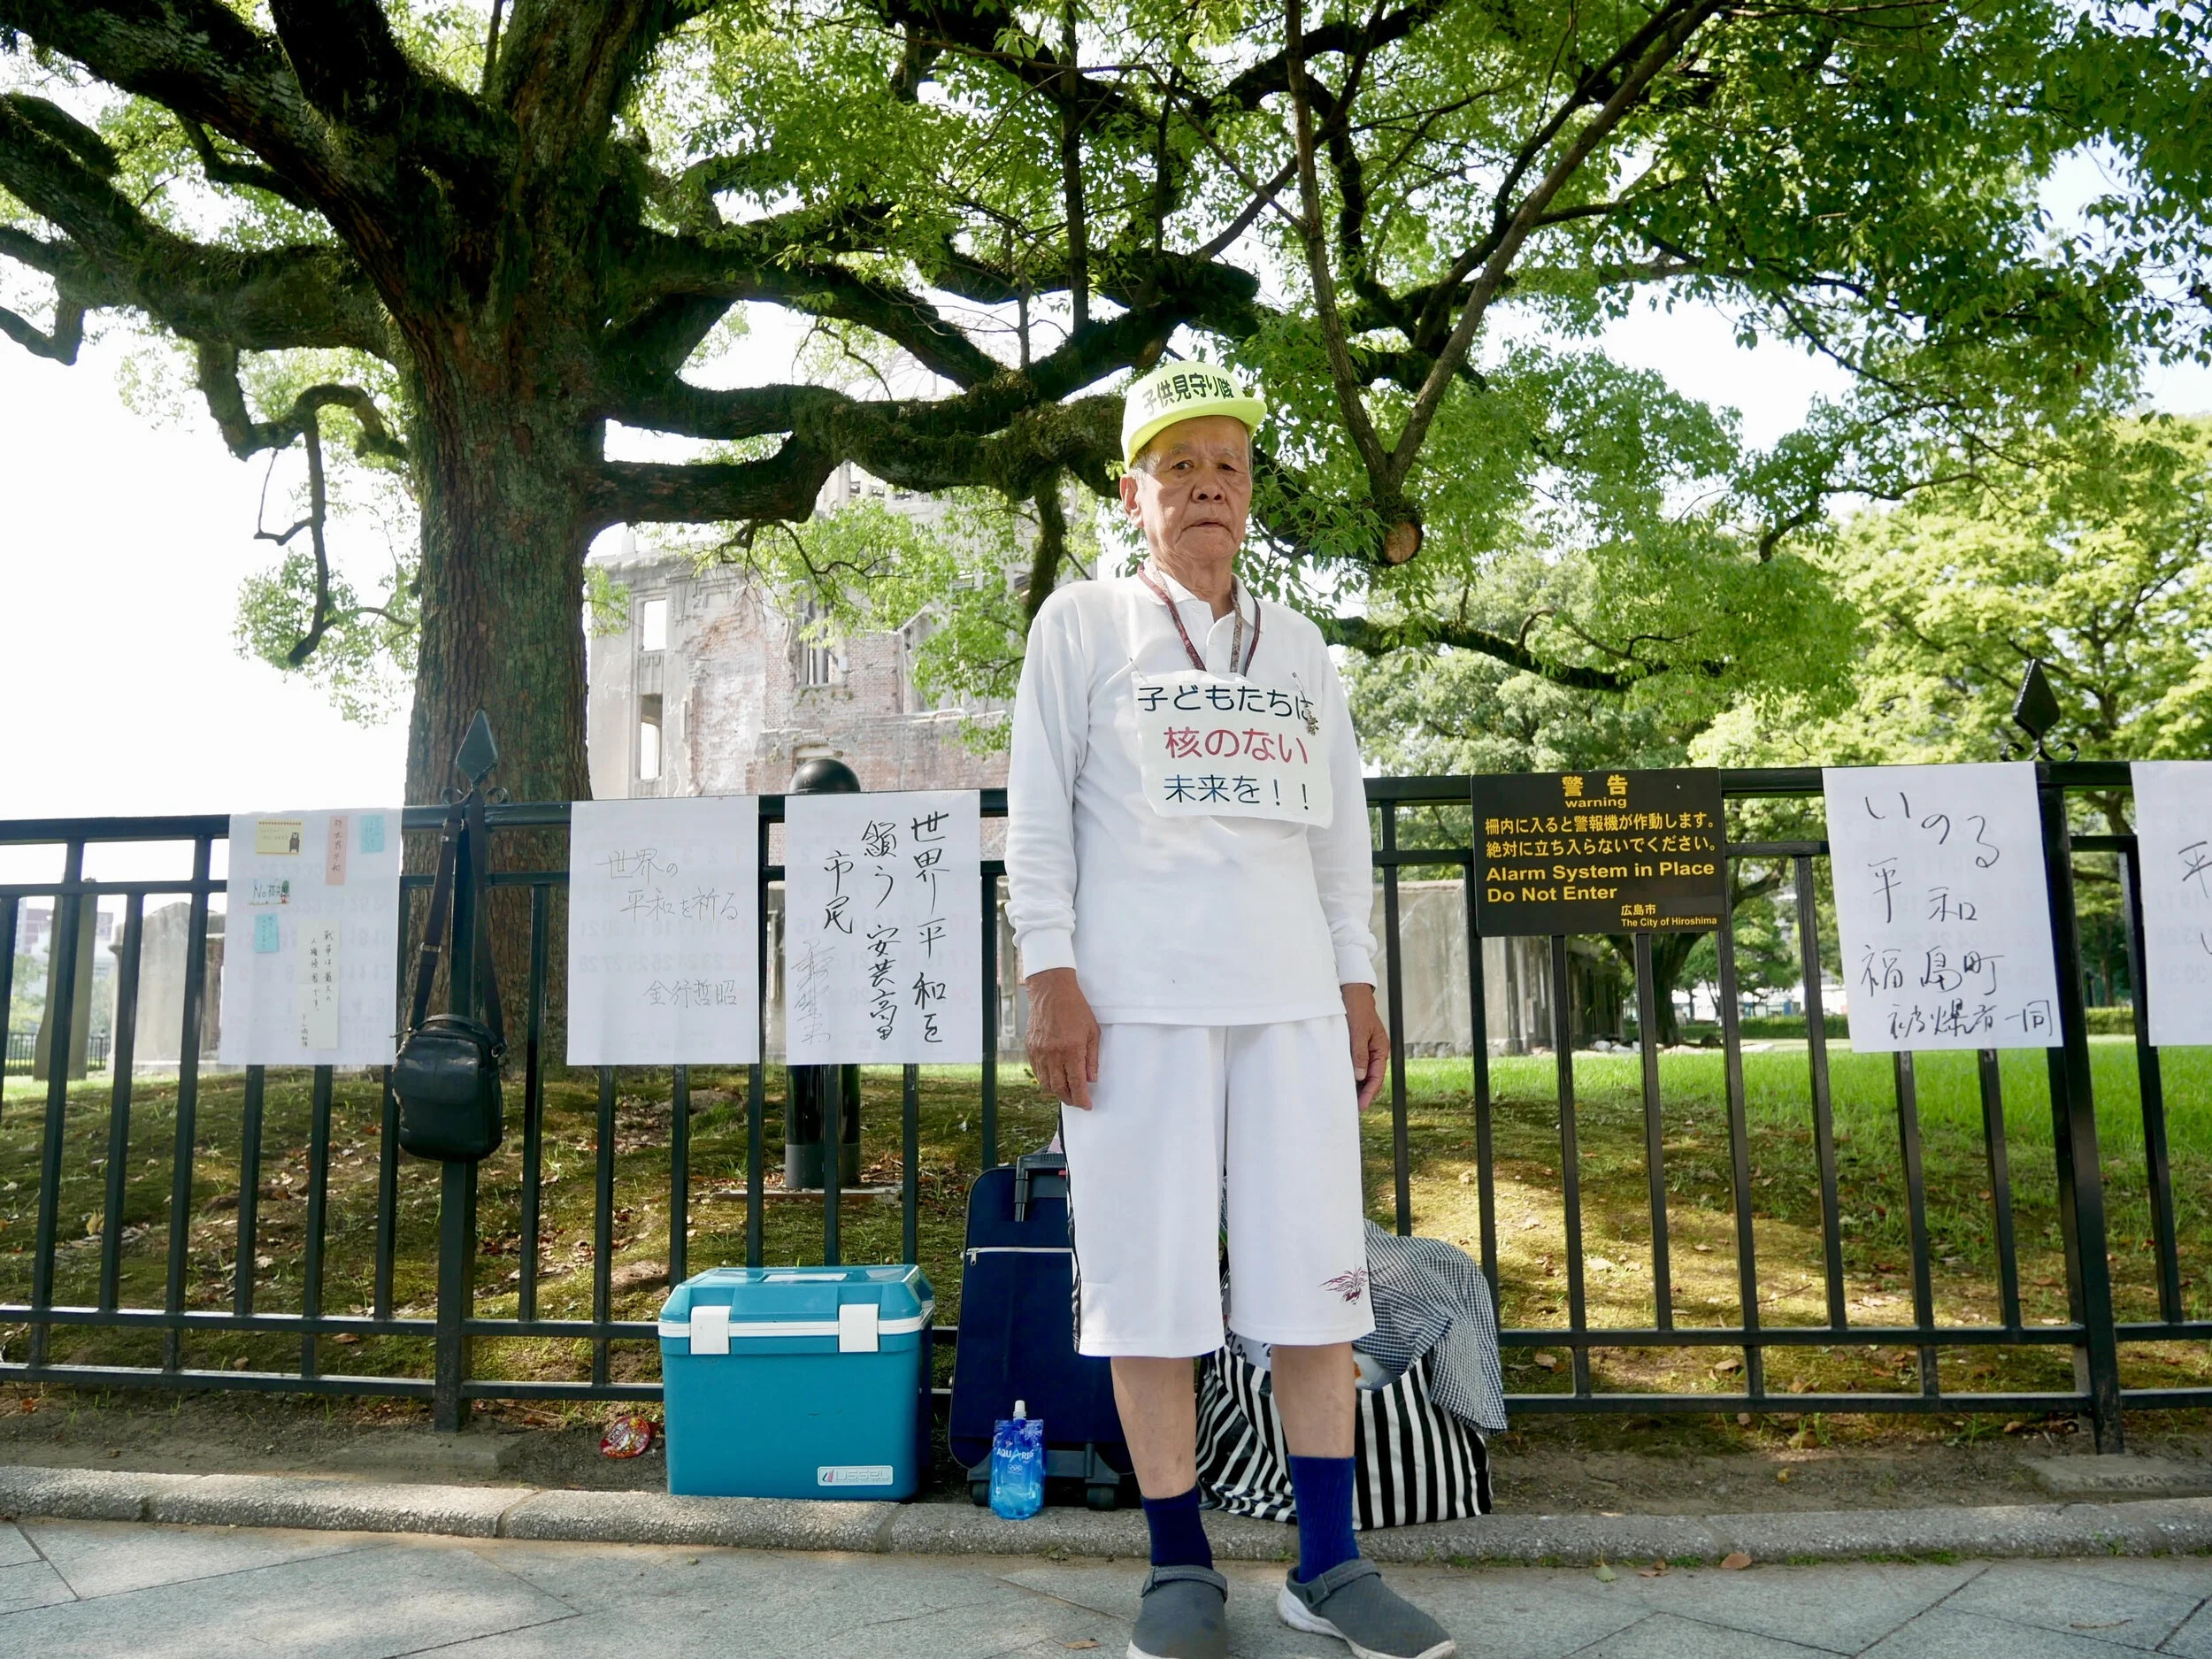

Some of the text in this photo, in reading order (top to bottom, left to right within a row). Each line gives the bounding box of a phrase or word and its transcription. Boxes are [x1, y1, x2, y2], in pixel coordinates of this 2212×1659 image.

[1138, 684, 1314, 721] 子どもたちは
[1163, 726, 1309, 764] 核のない
[1564, 797, 1627, 809] warning
[1485, 811, 1714, 835] 柵内に入ると警報機が作動します。
[1865, 792, 2000, 869] いのる
[1486, 836, 1716, 858] 絶対に立ち入らないでください。
[595, 848, 679, 885] 世界の
[1486, 862, 1715, 882] Alarm System in Place
[619, 887, 738, 923] 平和を祈る
[1487, 886, 1617, 902] Do Not Enter
[1867, 856, 1978, 924] 平和
[910, 810, 951, 1044] 世界平和を
[1621, 903, 1656, 916] 広島市
[1621, 916, 1717, 928] The City of Hiroshima
[1860, 944, 2005, 997] 福島町
